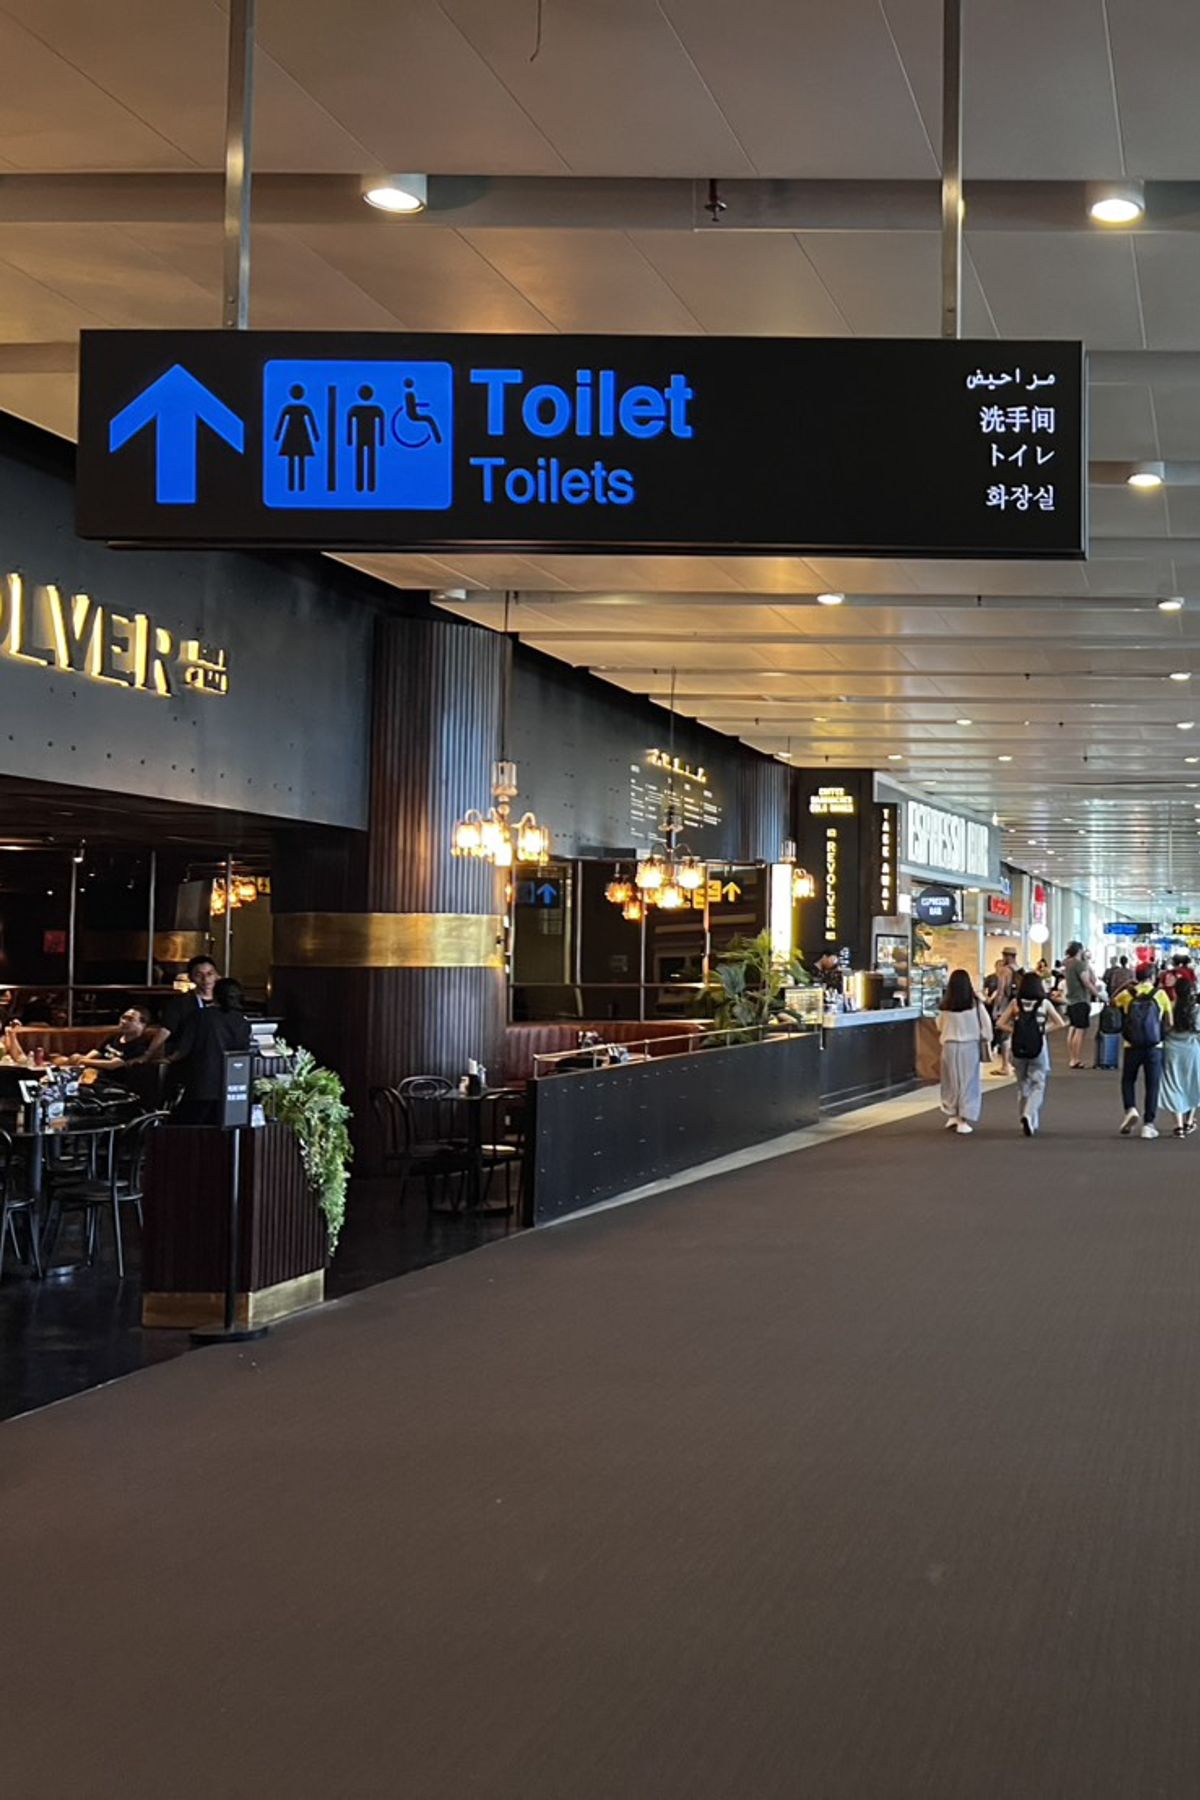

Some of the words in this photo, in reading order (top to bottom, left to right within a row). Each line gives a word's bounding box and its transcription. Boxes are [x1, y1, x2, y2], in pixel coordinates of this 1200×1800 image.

[966, 367, 1056, 390] مراحيض
[469, 369, 693, 439] Toilet
[979, 405, 1055, 434] 洗手间
[991, 443, 1055, 467] トイレ
[469, 457, 636, 504] Toilets
[986, 484, 1055, 511] 화장실
[881, 808, 890, 858] TAKE
[825, 841, 837, 929] REVOLVER
[880, 862, 891, 911] AWAY
